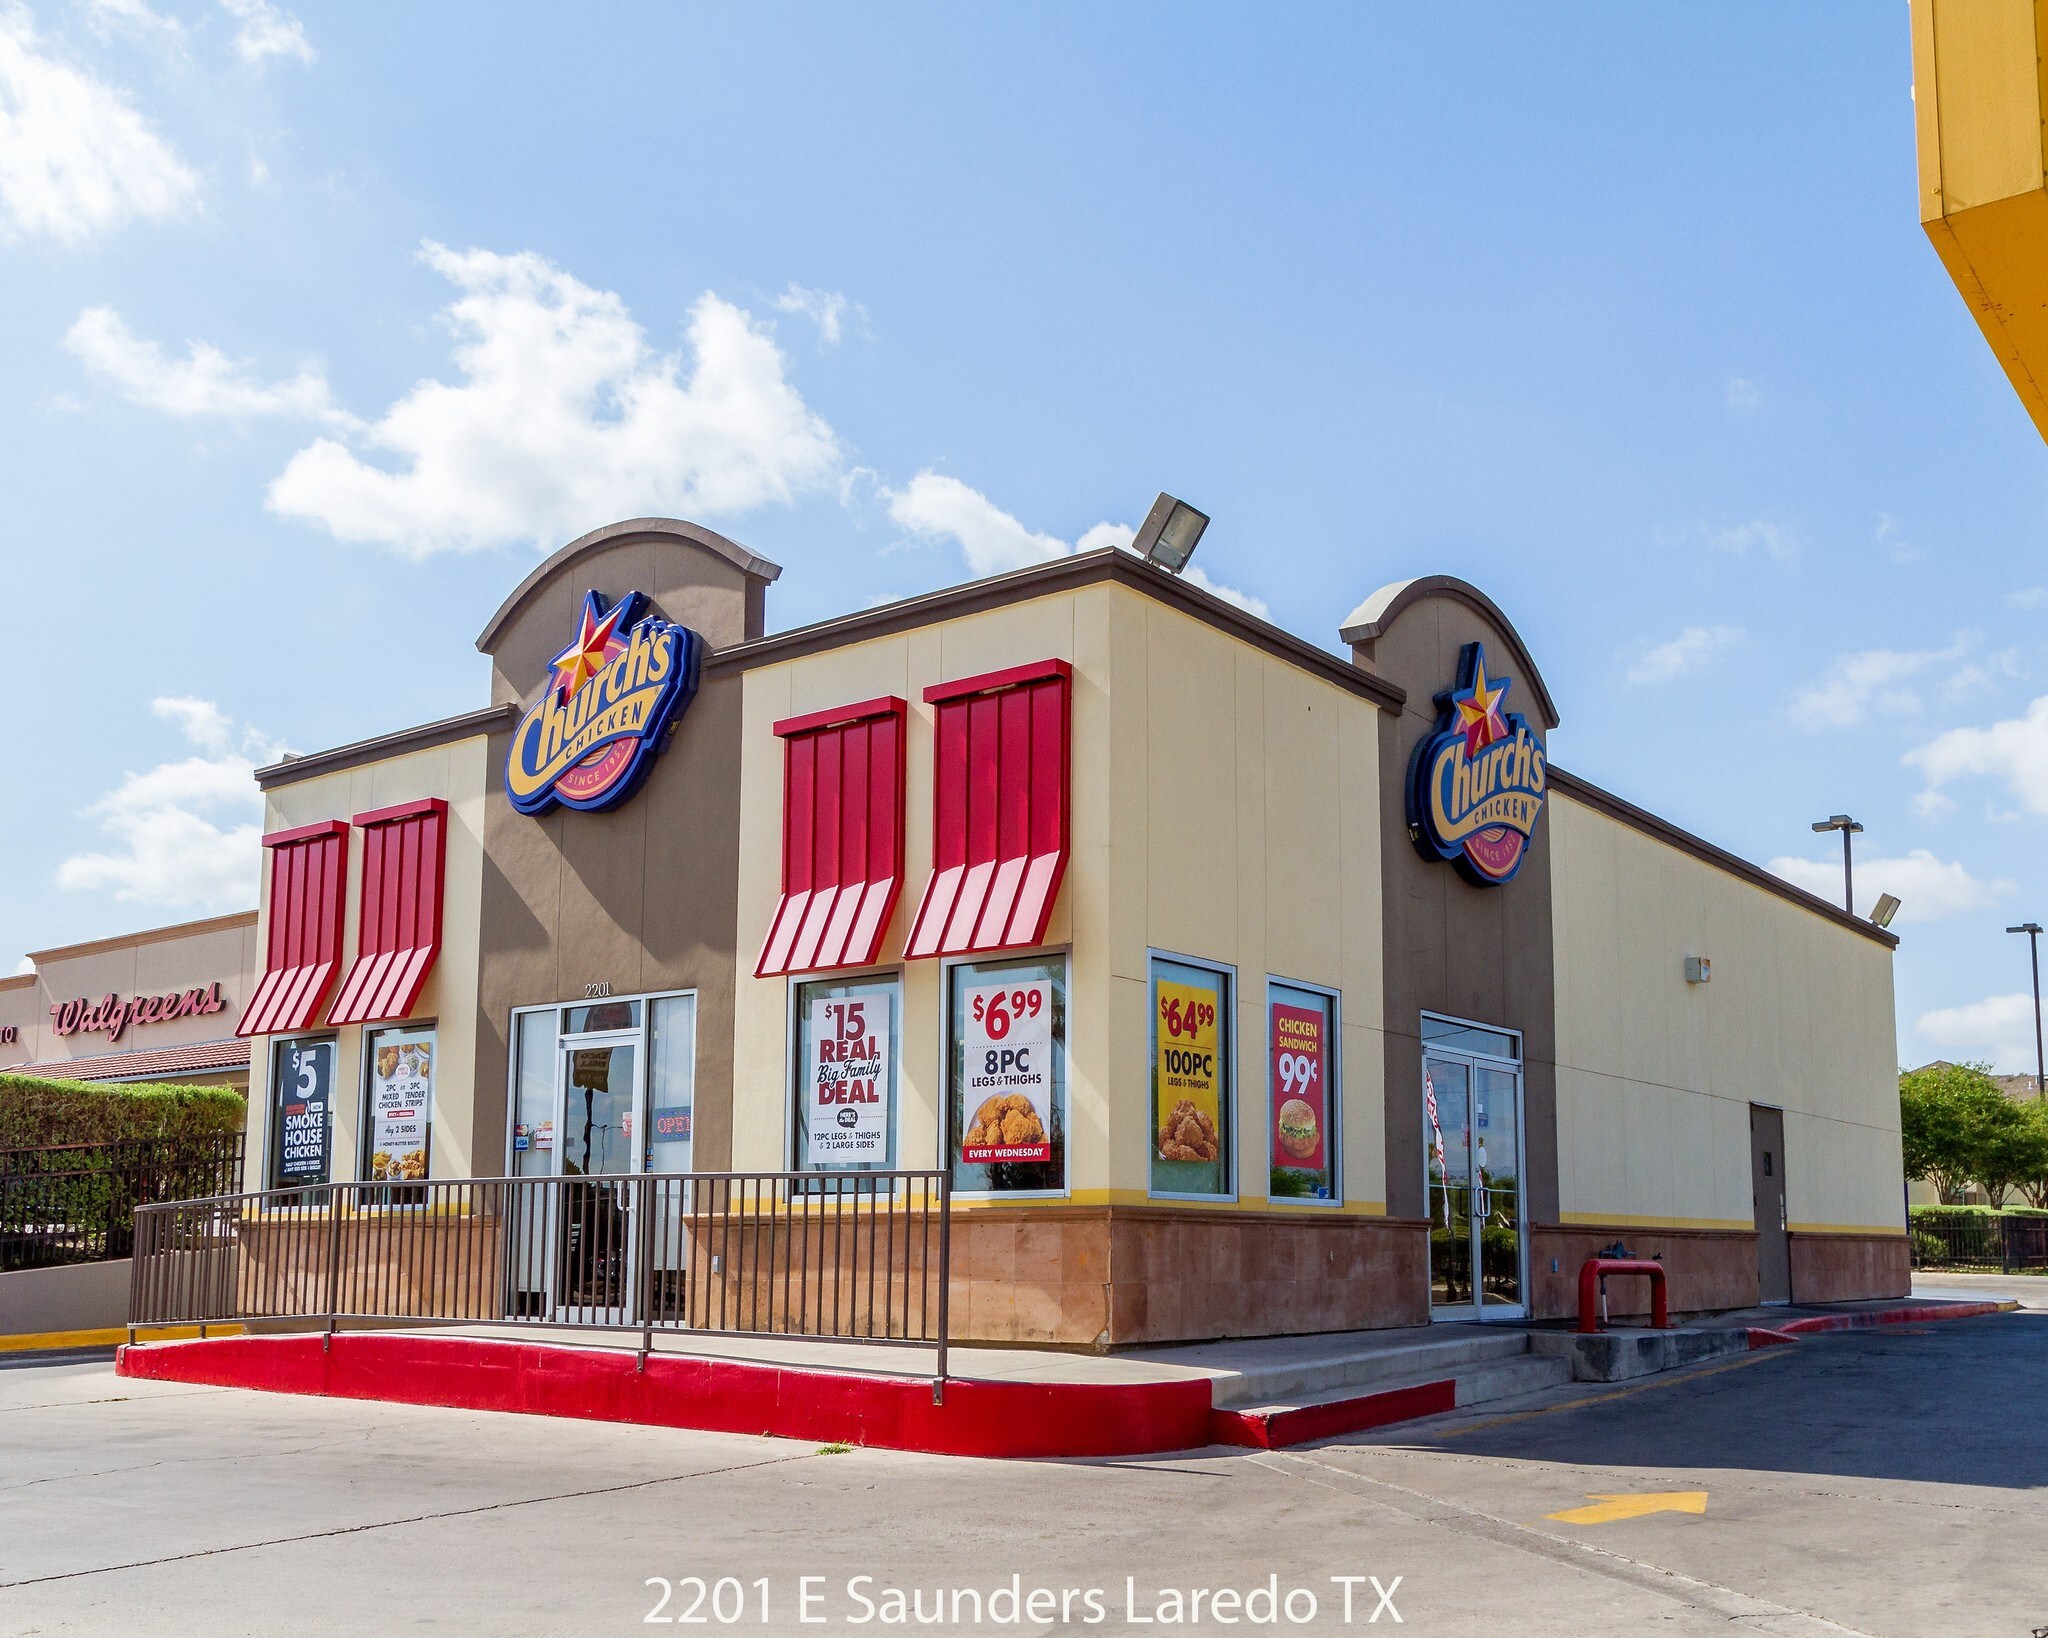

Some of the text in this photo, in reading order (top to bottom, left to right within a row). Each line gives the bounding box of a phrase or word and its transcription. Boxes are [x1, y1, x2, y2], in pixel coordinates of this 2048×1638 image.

[508, 628, 671, 796] Church's
[565, 701, 643, 759] CHICKEN
[568, 742, 625, 786] SINCE 1952
[1431, 727, 1545, 841] Church's
[1474, 798, 1528, 824] CHICKEN
[1475, 838, 1500, 861] SINCE
[585, 981, 610, 998] 2201
[49, 981, 223, 1042] Walgreens
[825, 1002, 866, 1041] $15
[1279, 1017, 1317, 1038] CHICKEN
[819, 1036, 881, 1063] REAL
[1279, 1036, 1317, 1053] SANDWICH
[817, 1053, 883, 1088] Big Family
[984, 1048, 1030, 1075] 8PC
[1164, 1049, 1213, 1078] 100PC
[291, 1049, 317, 1099] $5
[971, 1073, 1042, 1088] LEGS & THIGHS
[1167, 1077, 1210, 1090] LEGS & THIGHS
[1278, 1052, 1318, 1094] 99¢
[382, 1091, 425, 1101] MIXED TENDER
[410, 1082, 420, 1090] 3PC
[818, 1079, 879, 1105] DEAL
[378, 1099, 423, 1109] CHICKEN STRIPS
[285, 1113, 323, 1130] SMOKE
[395, 1125, 400, 1134] 2
[401, 1125, 416, 1133] SIDES
[285, 1128, 322, 1147] HOUSE
[814, 1133, 830, 1141] 12PC
[831, 1132, 847, 1140] LEGS
[854, 1131, 881, 1140] THIGHS
[819, 1139, 875, 1149] & 2 LARGE SIDES
[284, 1145, 322, 1160] CHICKEN
[968, 1147, 1044, 1158] EVERY WEDNESDAY
